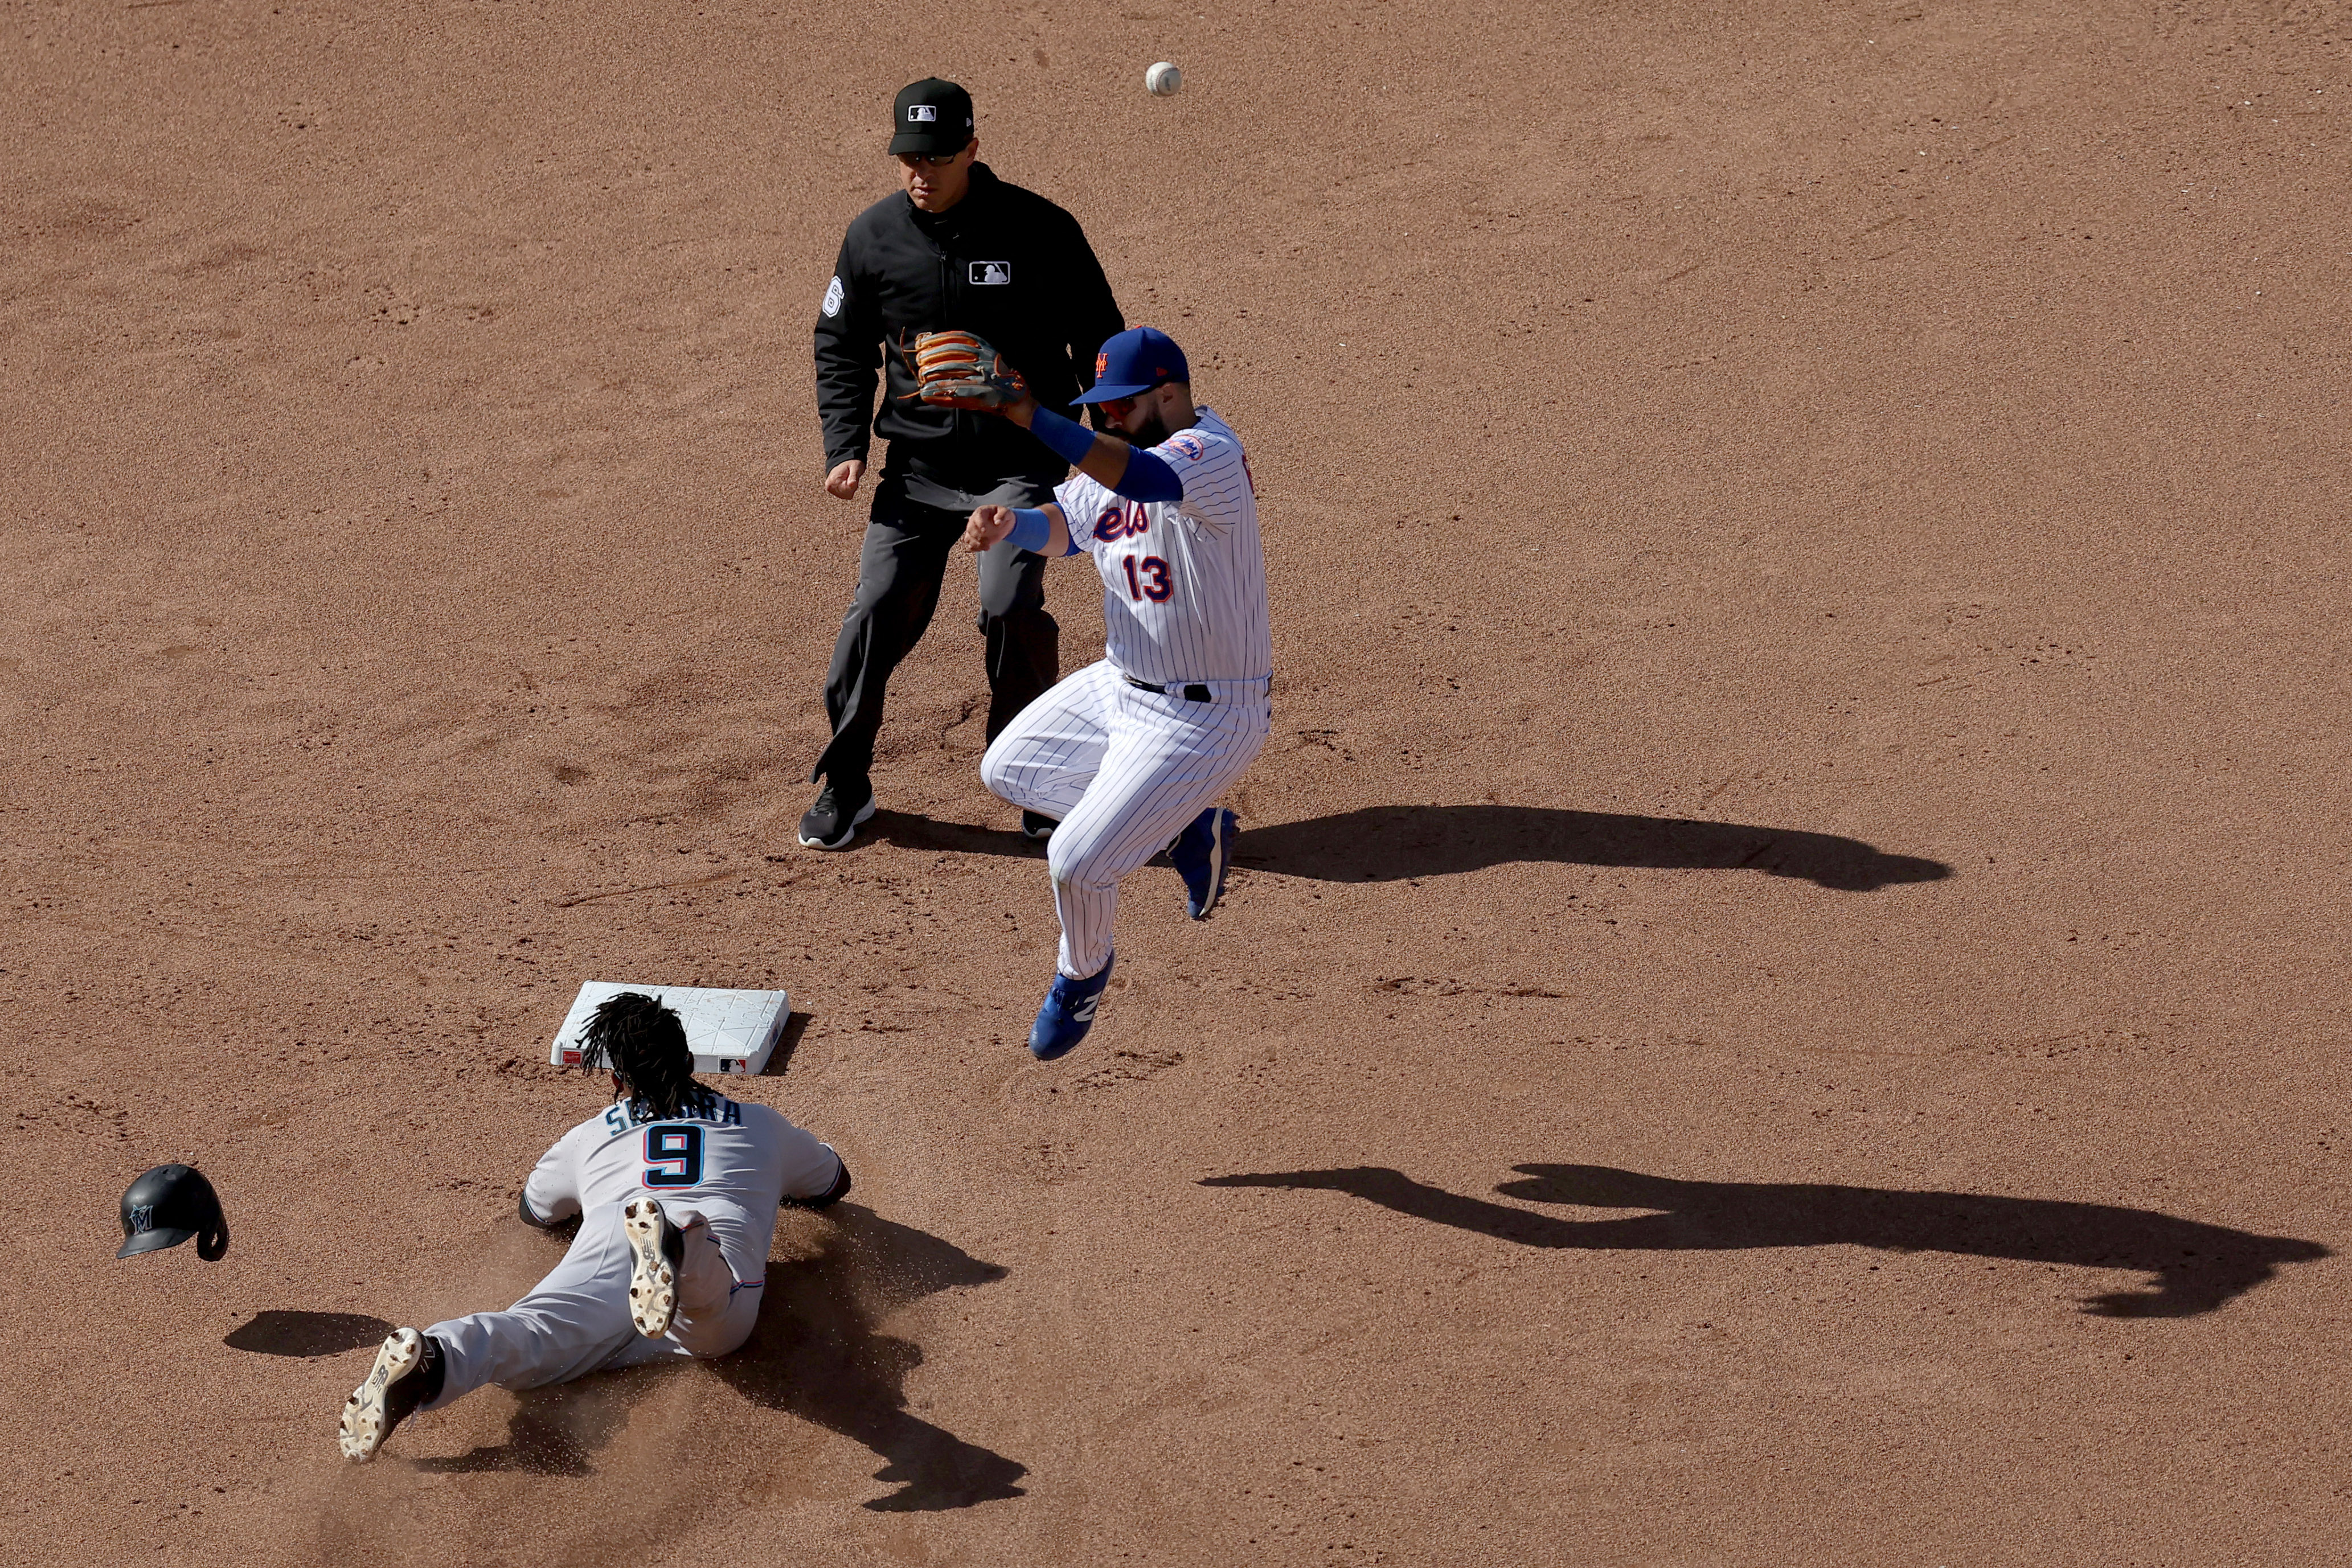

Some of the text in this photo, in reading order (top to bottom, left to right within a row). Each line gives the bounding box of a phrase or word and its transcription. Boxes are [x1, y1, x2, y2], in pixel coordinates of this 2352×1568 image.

[822, 276, 845, 317] 6
[1123, 555, 1174, 603] 13
[642, 1123, 705, 1189] 9
[129, 1204, 153, 1235] M
